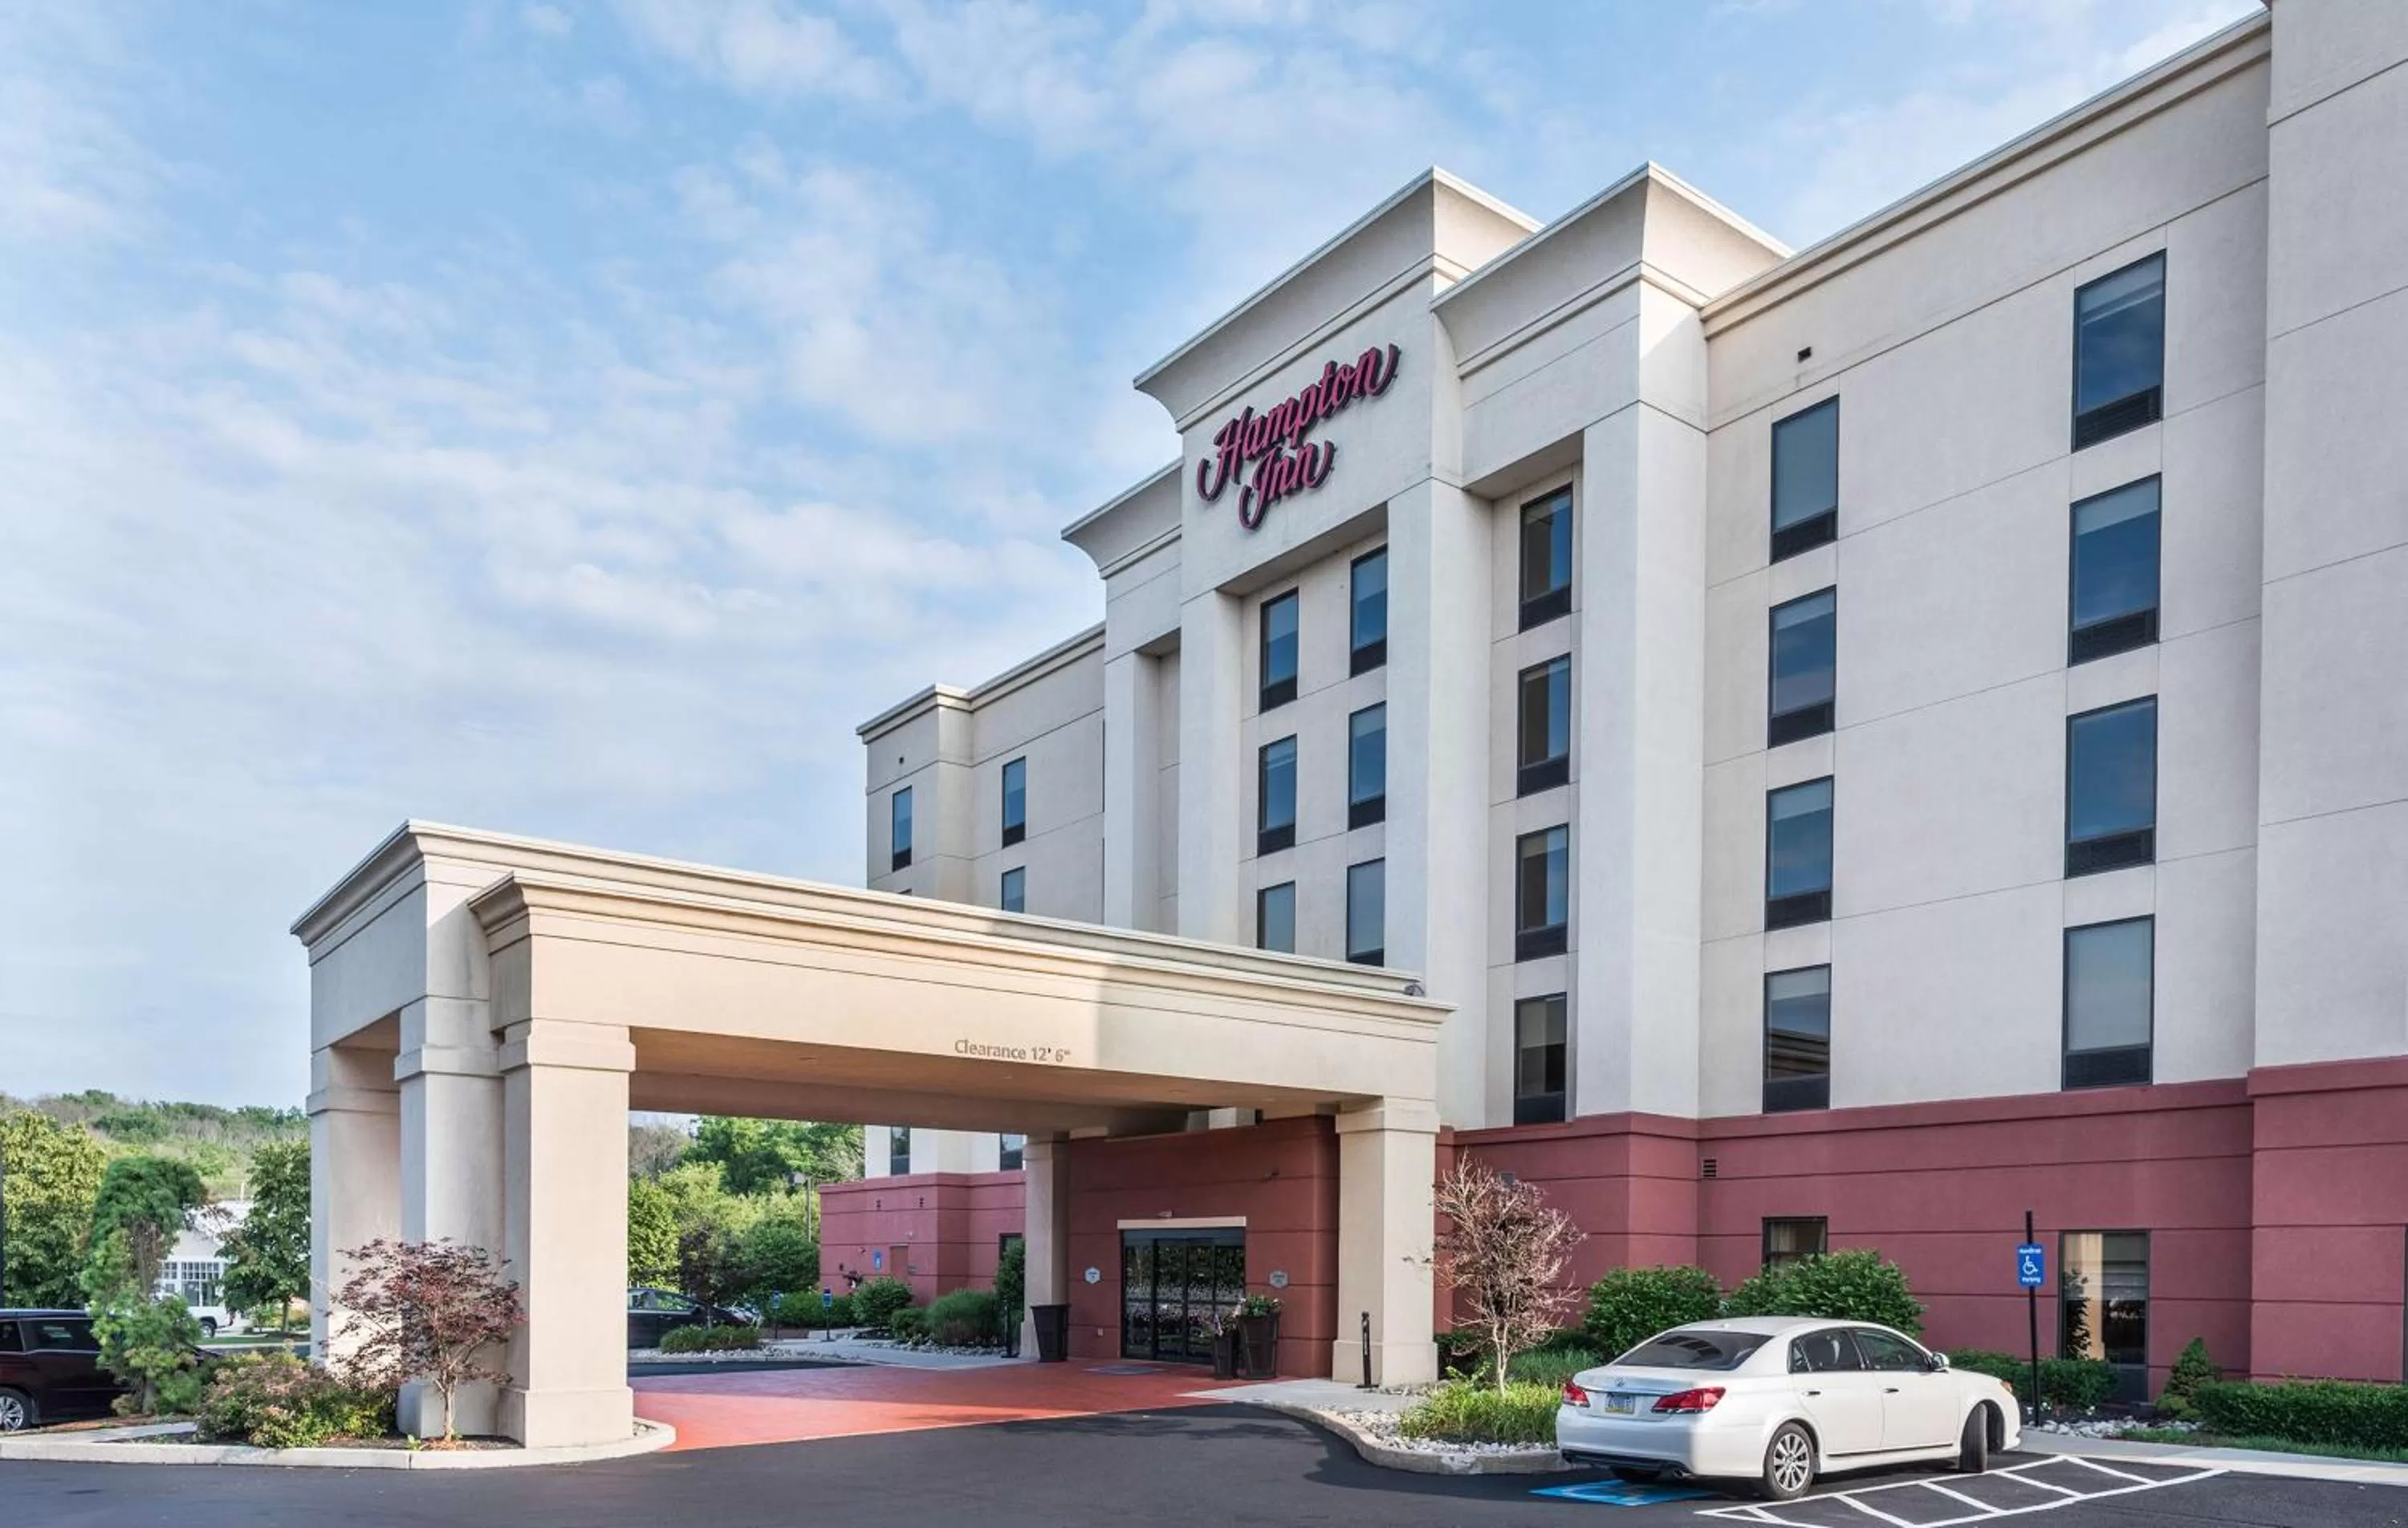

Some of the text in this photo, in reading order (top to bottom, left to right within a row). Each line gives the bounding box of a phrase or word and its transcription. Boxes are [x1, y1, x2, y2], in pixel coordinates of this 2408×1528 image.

[1197, 343, 1401, 502] Hampton
[1239, 440, 1336, 530] Inn
[954, 1038, 1027, 1060] Clearance
[1031, 1046, 1051, 1062] 12'
